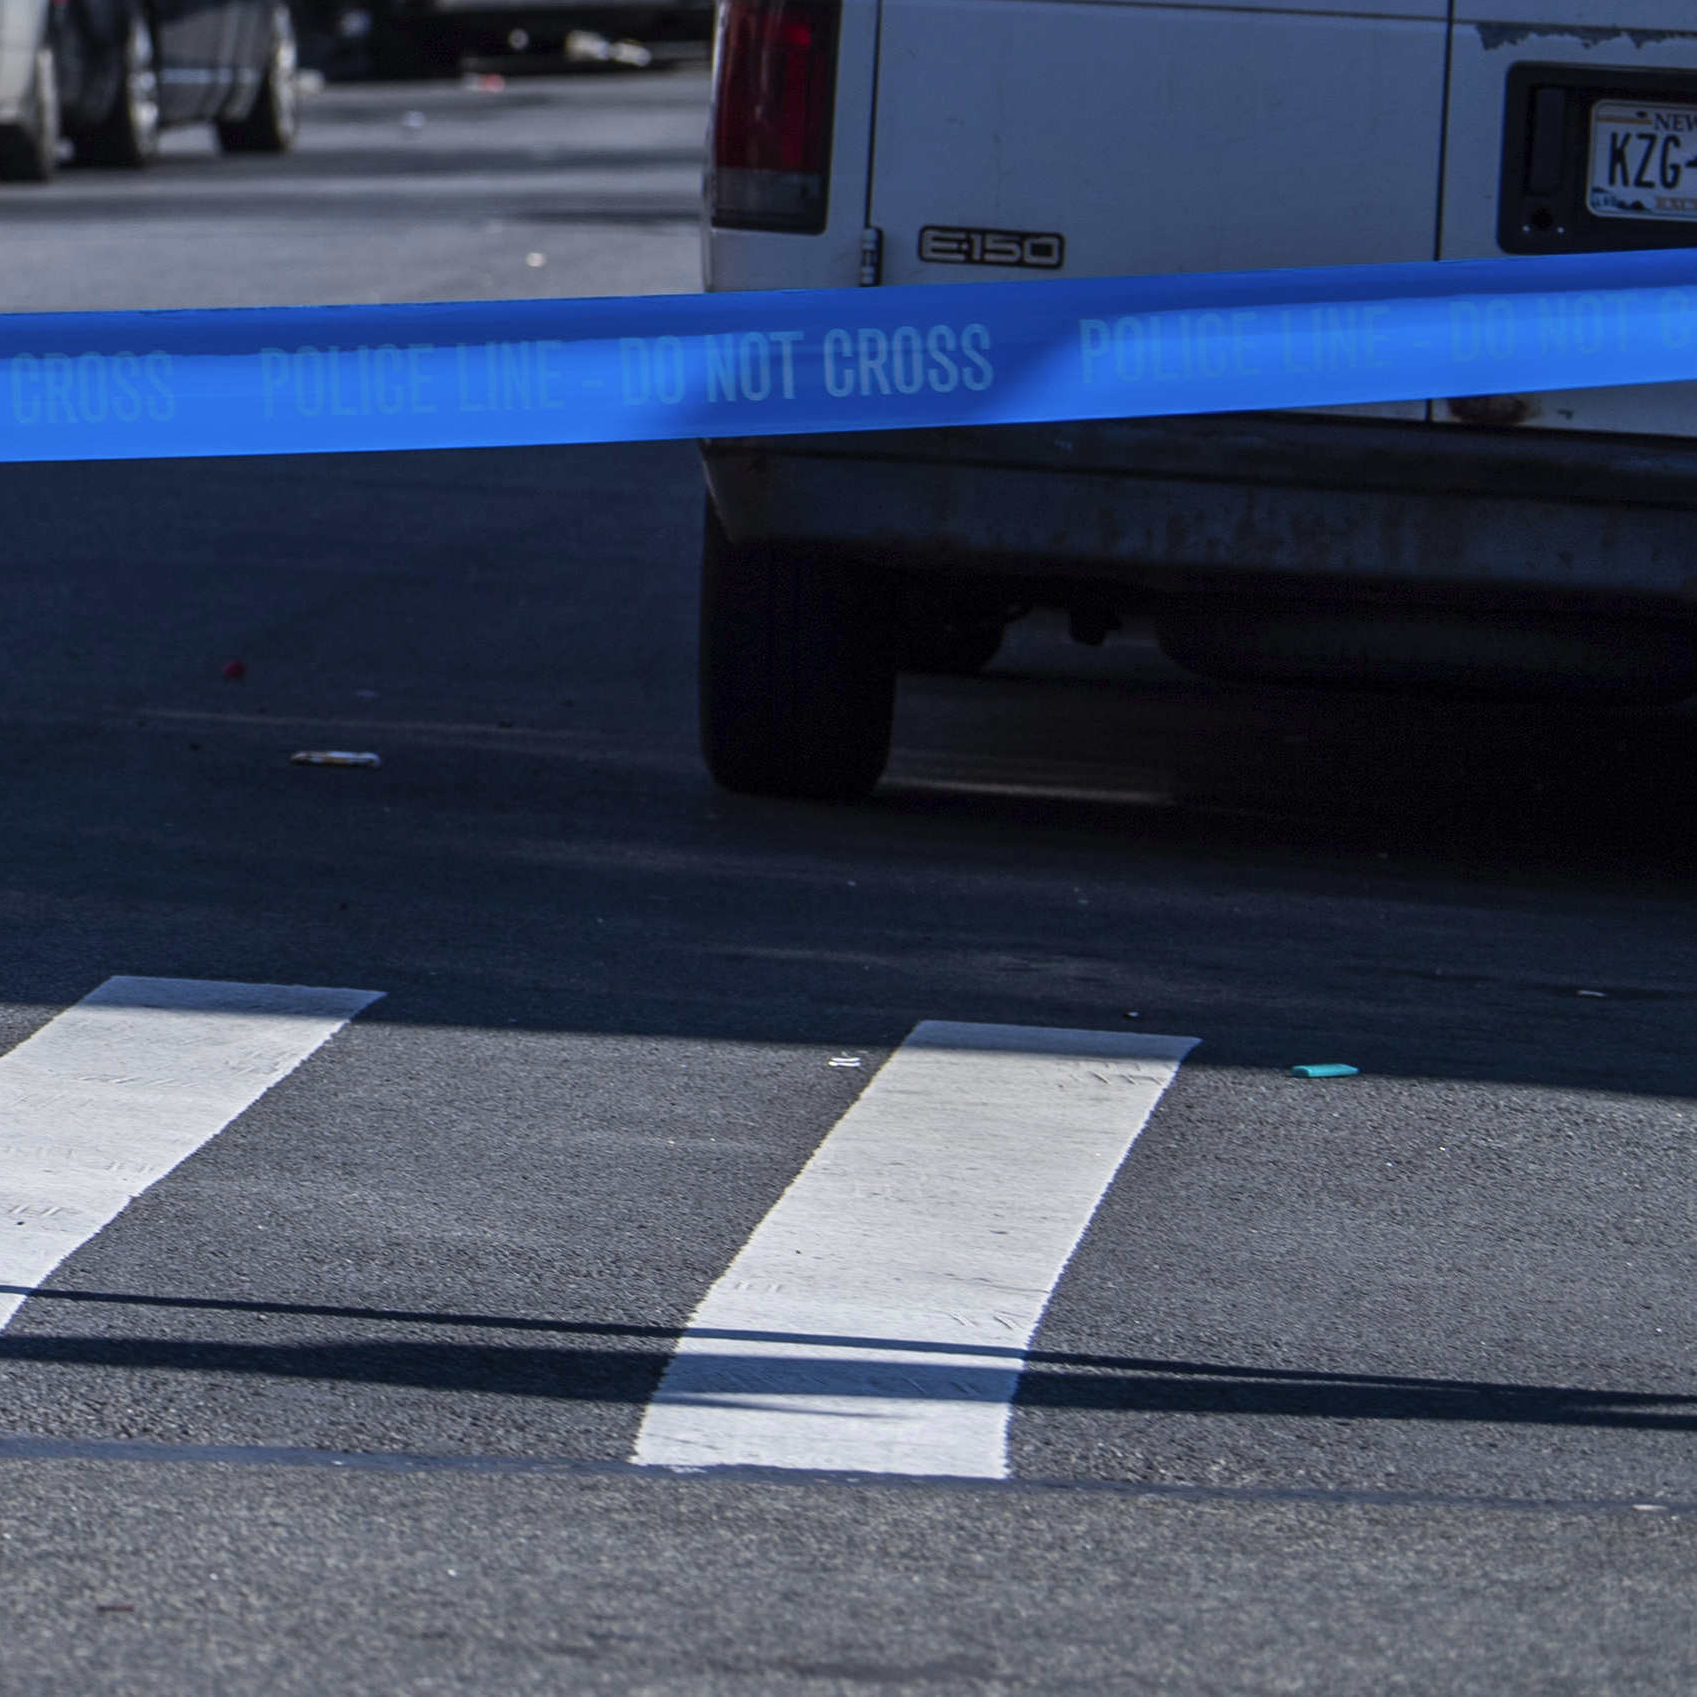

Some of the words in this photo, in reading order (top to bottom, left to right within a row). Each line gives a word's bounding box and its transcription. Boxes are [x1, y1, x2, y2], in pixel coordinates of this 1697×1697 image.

[260, 343, 438, 418] POLICE
[456, 339, 565, 412] LINE
[619, 334, 685, 406] DO
[705, 330, 804, 403] NOT
[823, 323, 994, 398] CROSS
[1079, 311, 1260, 384] POLICE
[1280, 305, 1393, 373] LINE
[1450, 298, 1517, 362] DO
[1538, 293, 1638, 356] NOT
[11, 349, 176, 425] CROSS
